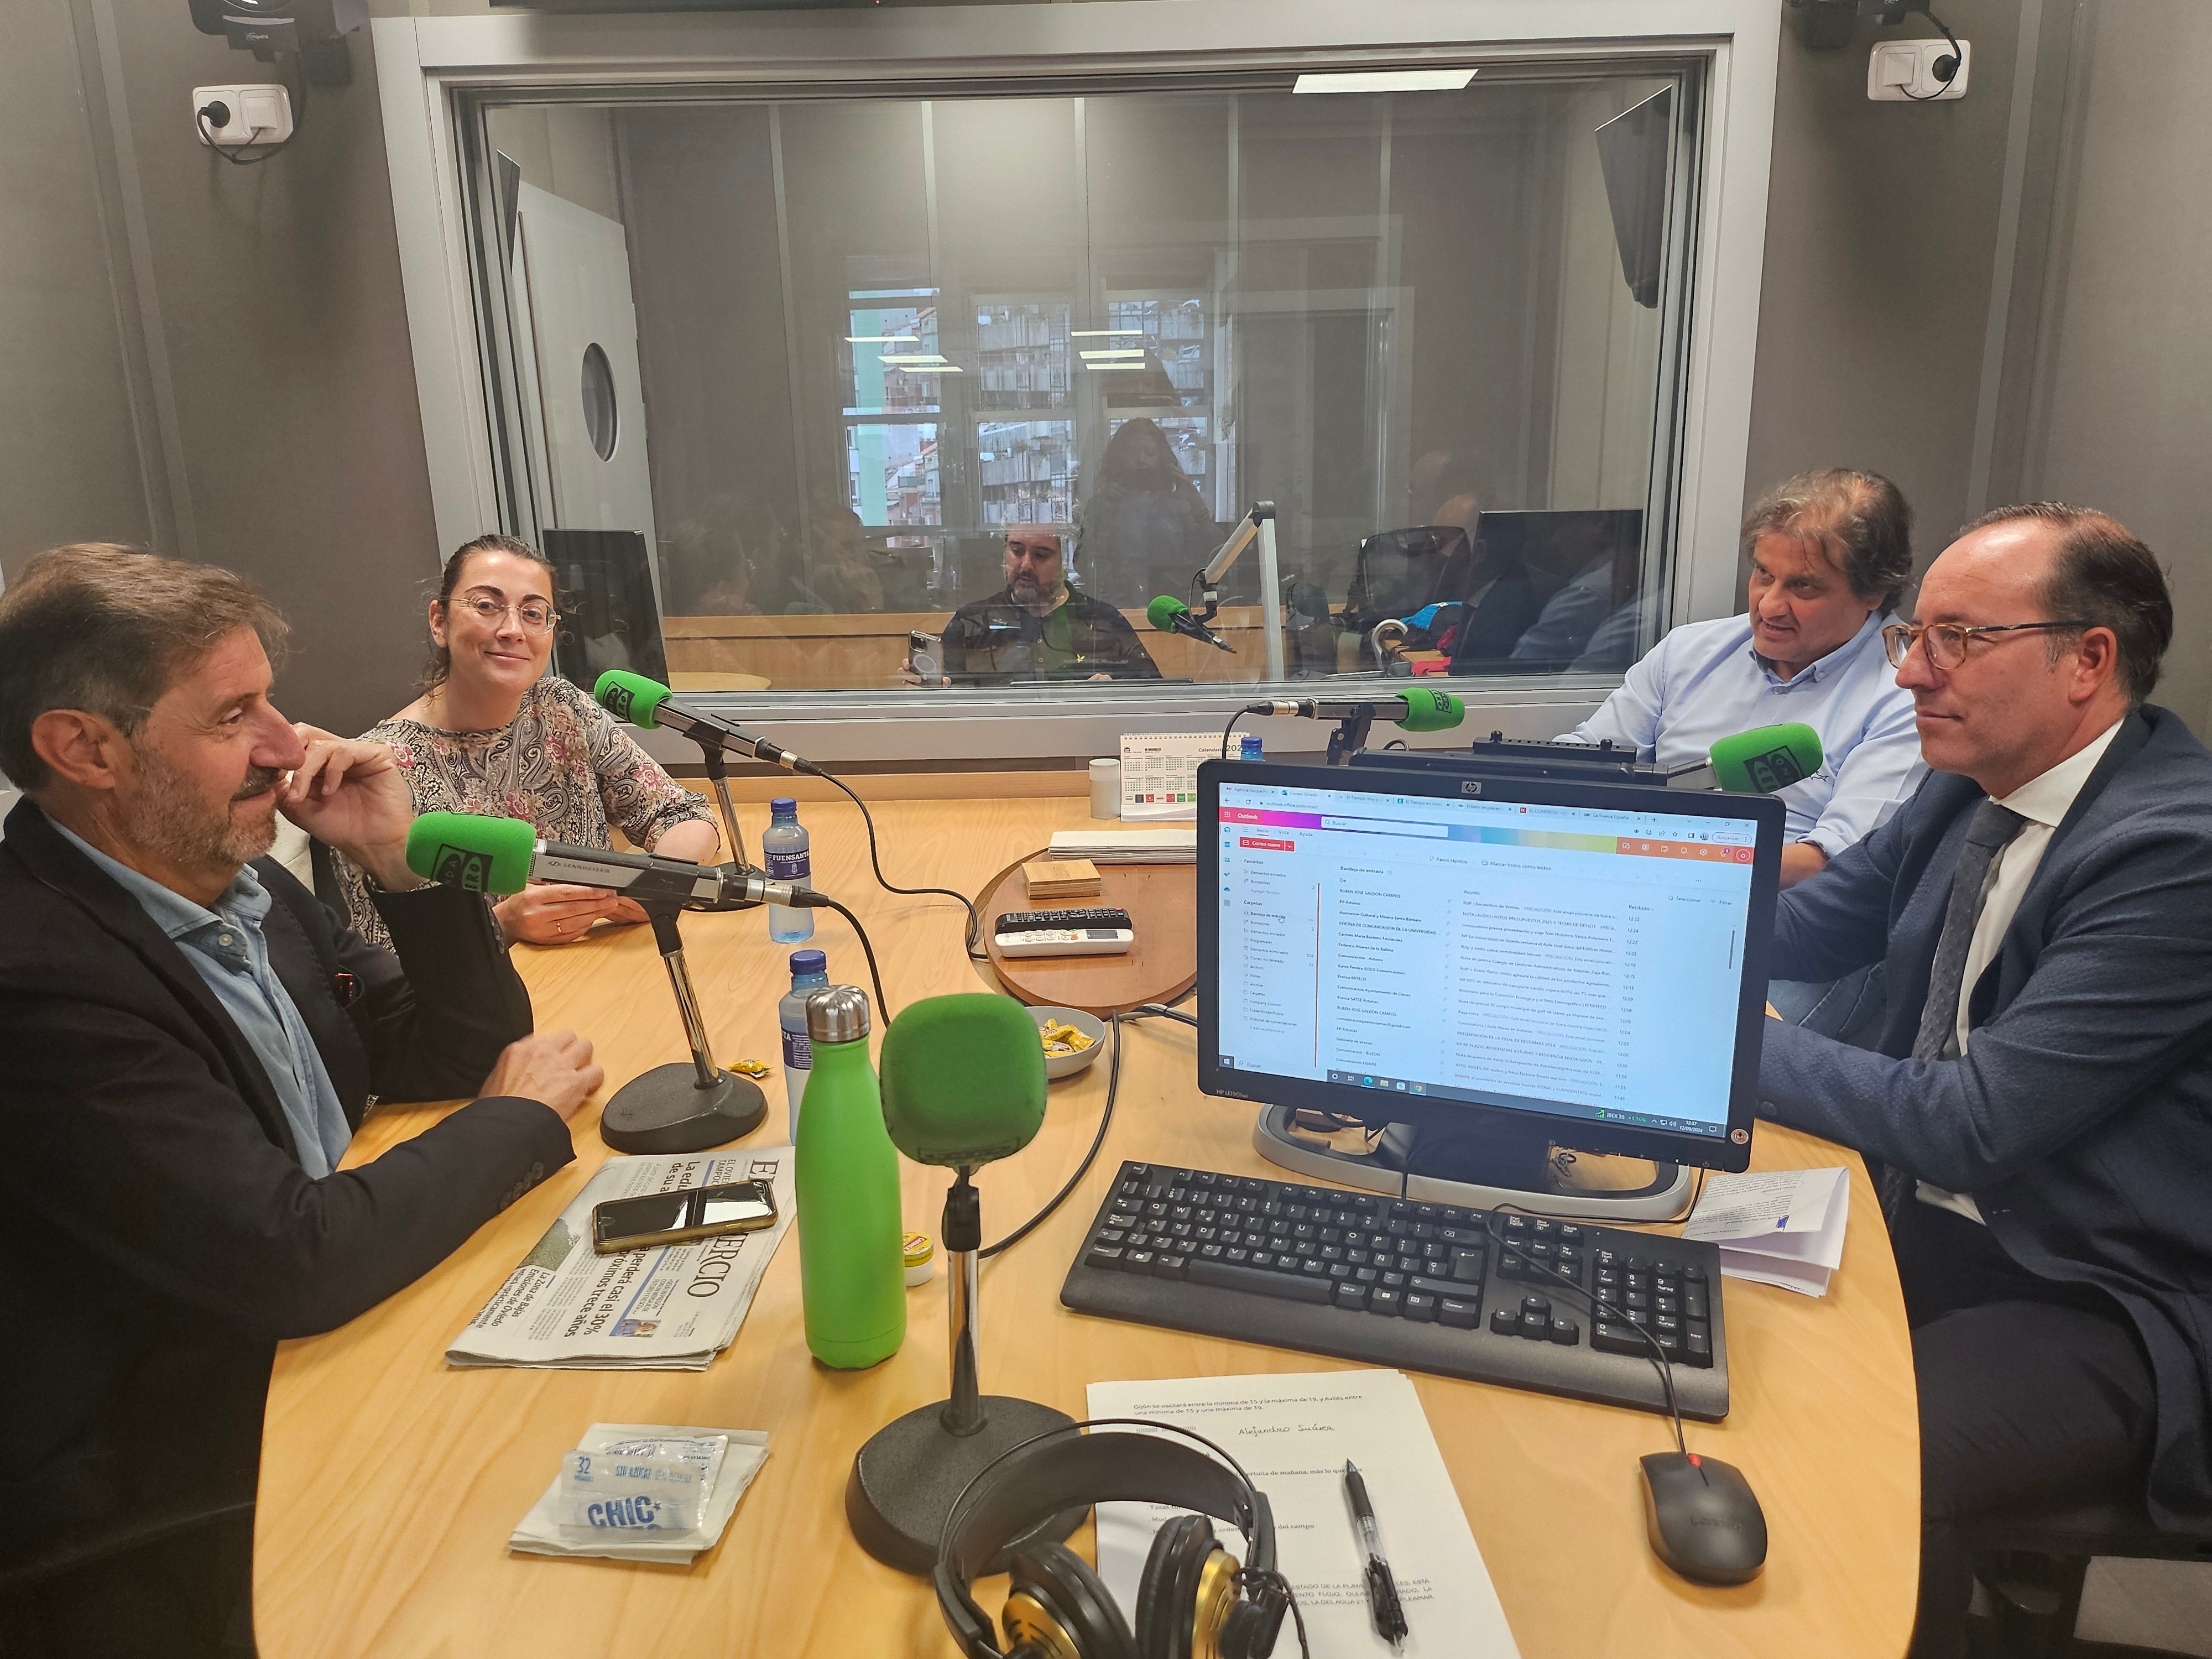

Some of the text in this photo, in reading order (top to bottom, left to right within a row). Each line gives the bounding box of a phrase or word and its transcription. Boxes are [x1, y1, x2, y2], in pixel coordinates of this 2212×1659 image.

[1678, 1124, 1703, 1133] 12/09/2024
[663, 1163, 684, 1185] de su
[675, 1161, 700, 1192] La edu
[711, 1160, 727, 1184] TAMPOC
[1378, 1253, 1385, 1261] Ñ
[540, 1271, 551, 1280] La
[617, 1253, 645, 1284] perderá
[514, 1269, 539, 1296] Emisiones
[529, 1279, 545, 1293] Zona
[564, 1250, 629, 1337] próximos trece años
[606, 1286, 624, 1301] casi
[492, 1306, 512, 1326] Oviedo
[512, 1302, 529, 1317] Bajas
[584, 1314, 609, 1334] 30%
[1238, 1423, 1335, 1437] Alejandro Suárez
[578, 1456, 591, 1474] 32
[588, 1495, 656, 1528] CHIC
